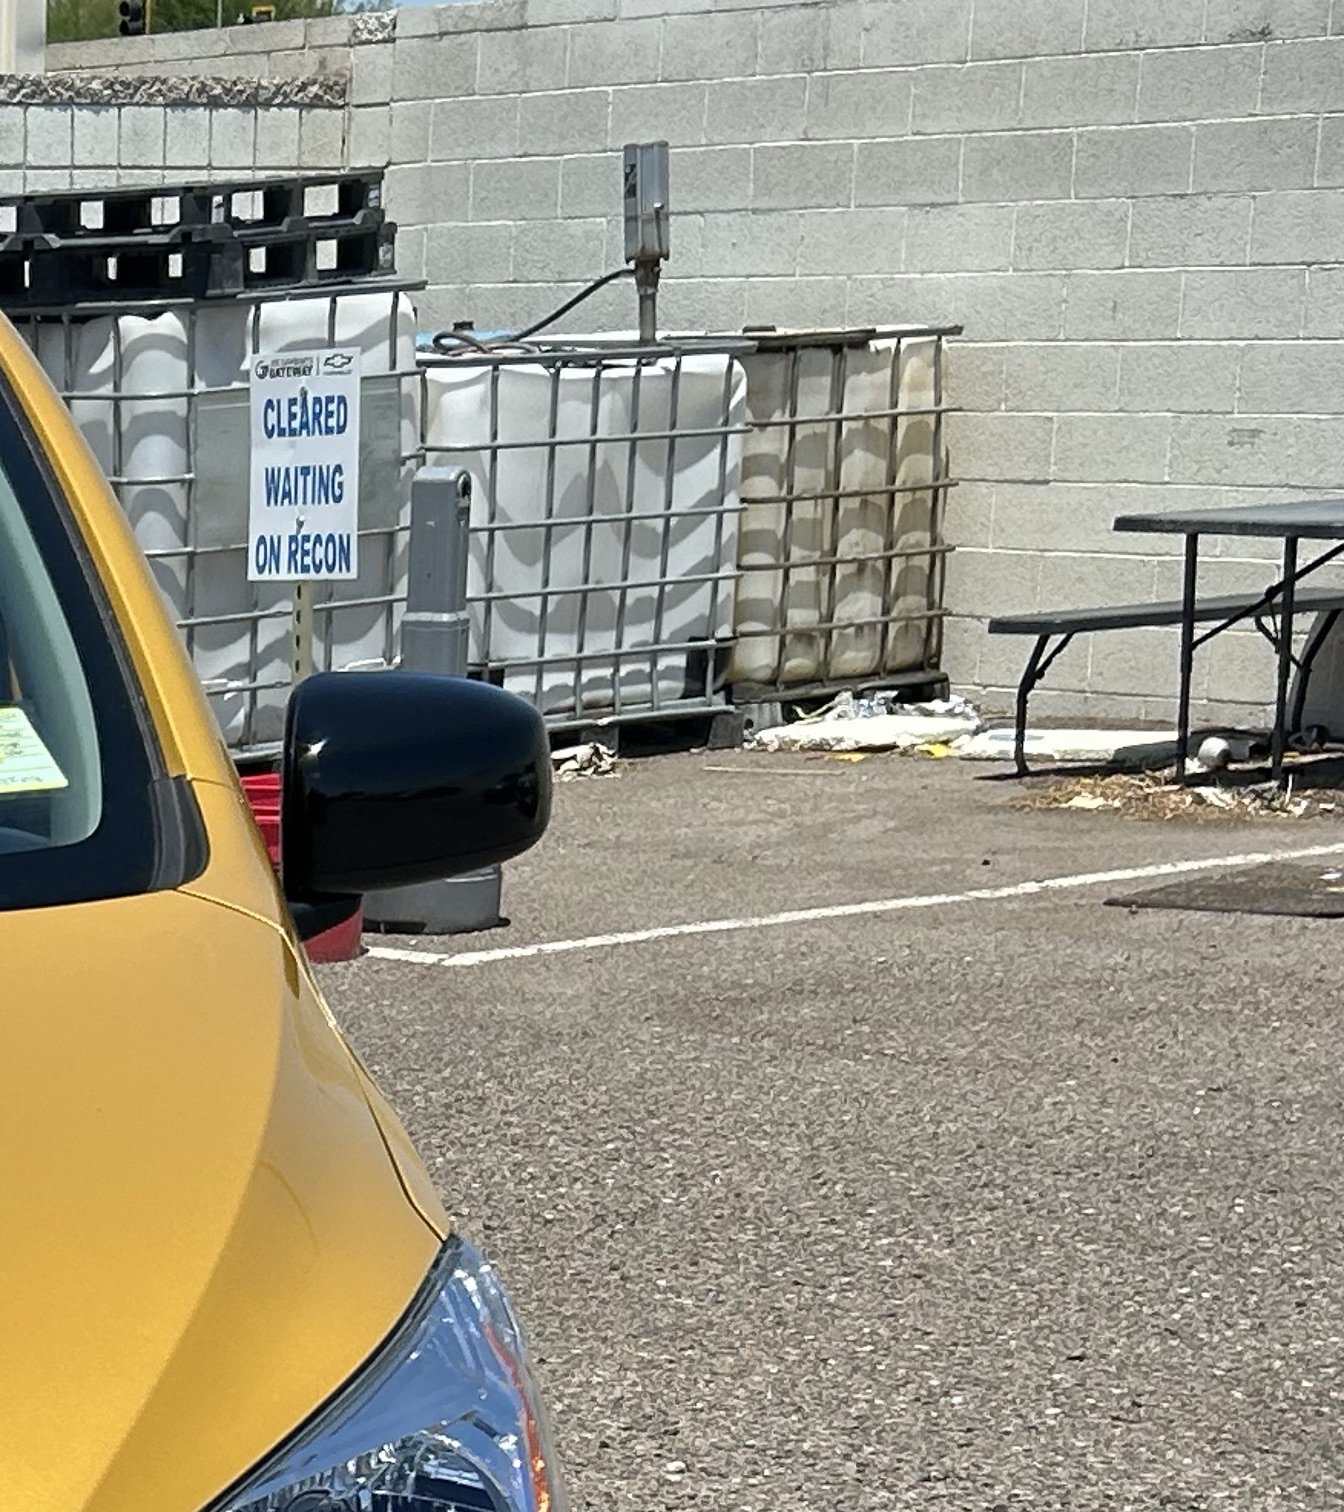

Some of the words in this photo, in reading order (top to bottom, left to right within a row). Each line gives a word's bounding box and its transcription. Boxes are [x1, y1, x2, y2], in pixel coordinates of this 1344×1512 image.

[264, 395, 348, 439] CLEARED
[265, 464, 344, 507] WAITING
[255, 534, 281, 575] ON
[287, 533, 351, 575] RECON
